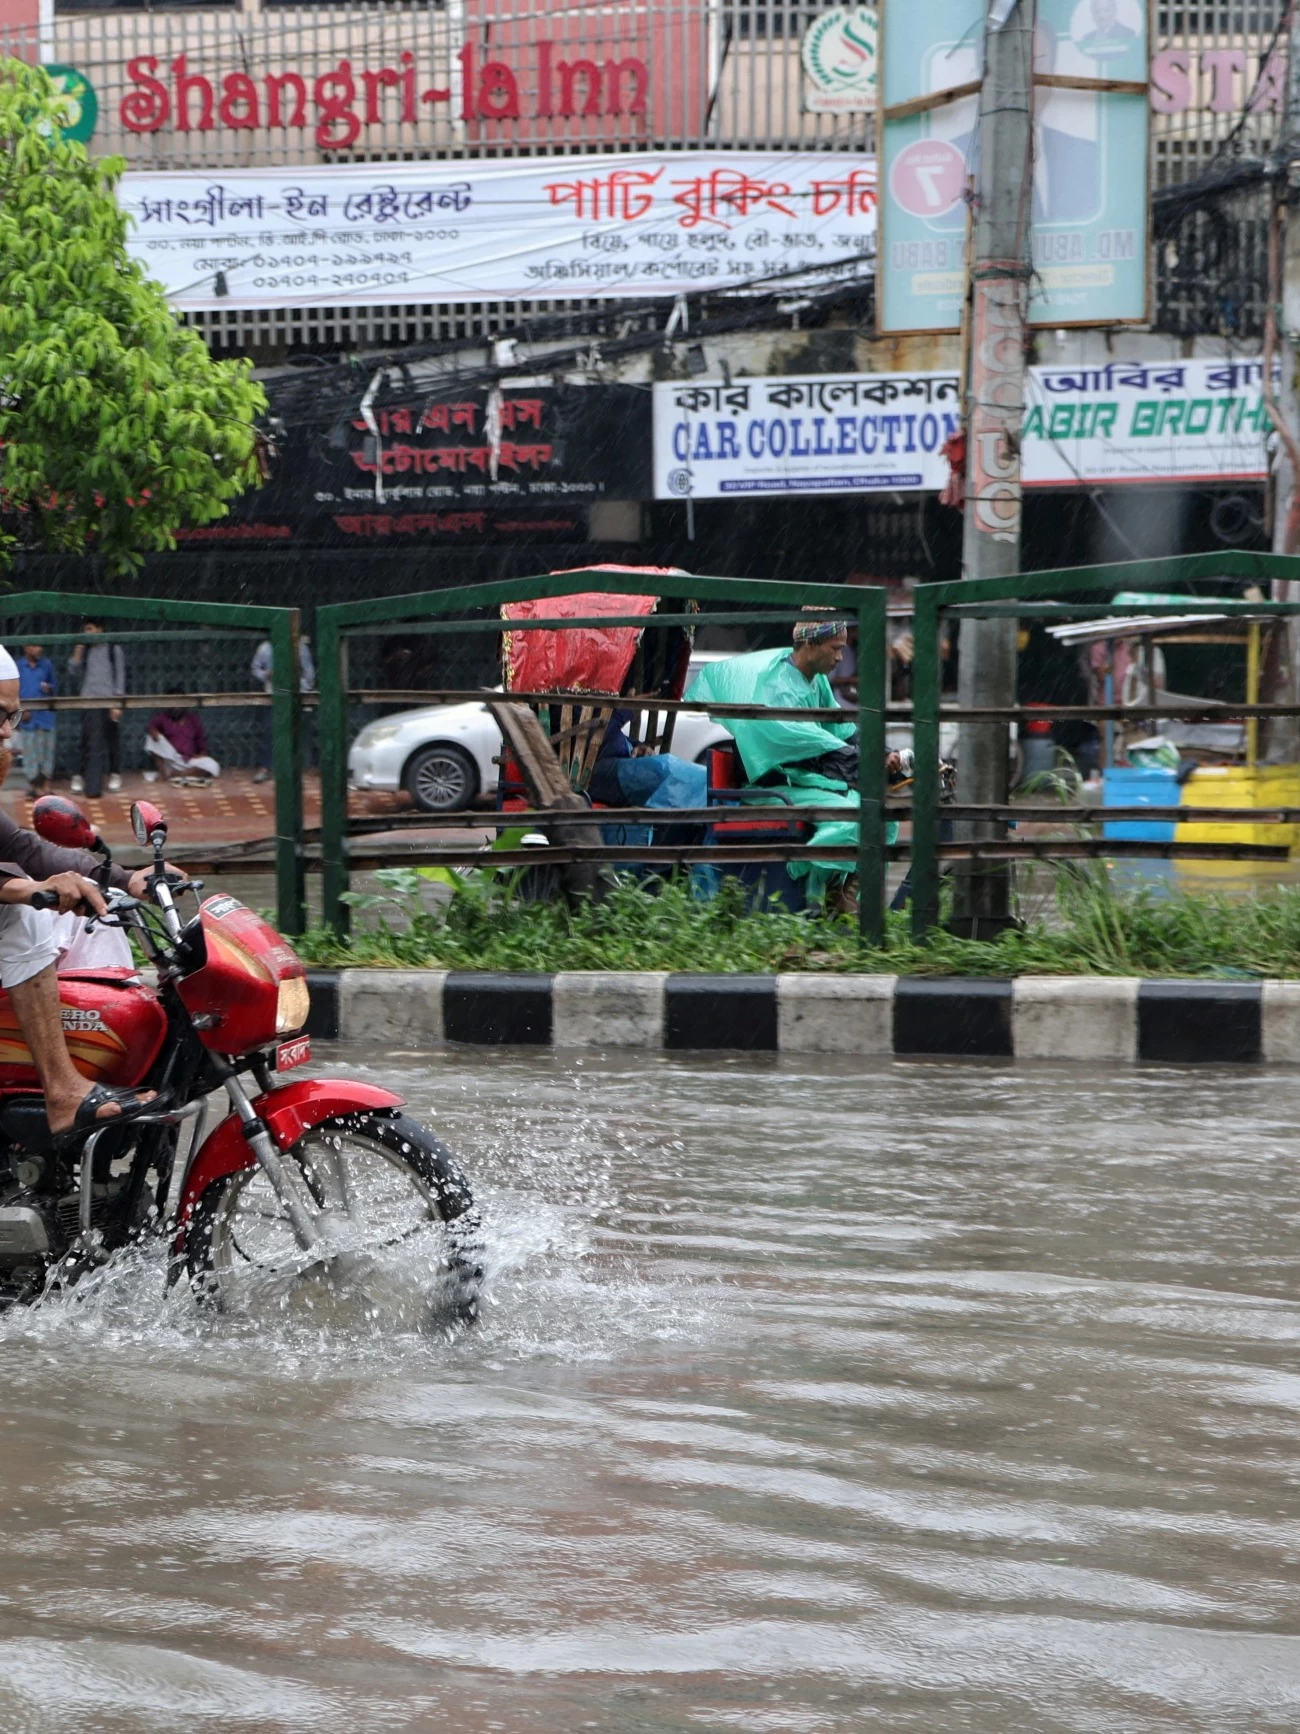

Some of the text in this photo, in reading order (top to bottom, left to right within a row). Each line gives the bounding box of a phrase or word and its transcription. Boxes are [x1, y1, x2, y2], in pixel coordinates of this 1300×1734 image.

[120, 40, 649, 149] Shangri-la Inn
[542, 166, 666, 222] পার্টি
[670, 168, 798, 230] বুকিং
[673, 377, 959, 416] কার কালেকশন
[1040, 363, 1186, 393] আবির
[673, 420, 740, 461] CAR
[1022, 403, 1118, 441] ABIR
[60, 1009, 100, 1020] ERO
[62, 1021, 109, 1031] NDA
